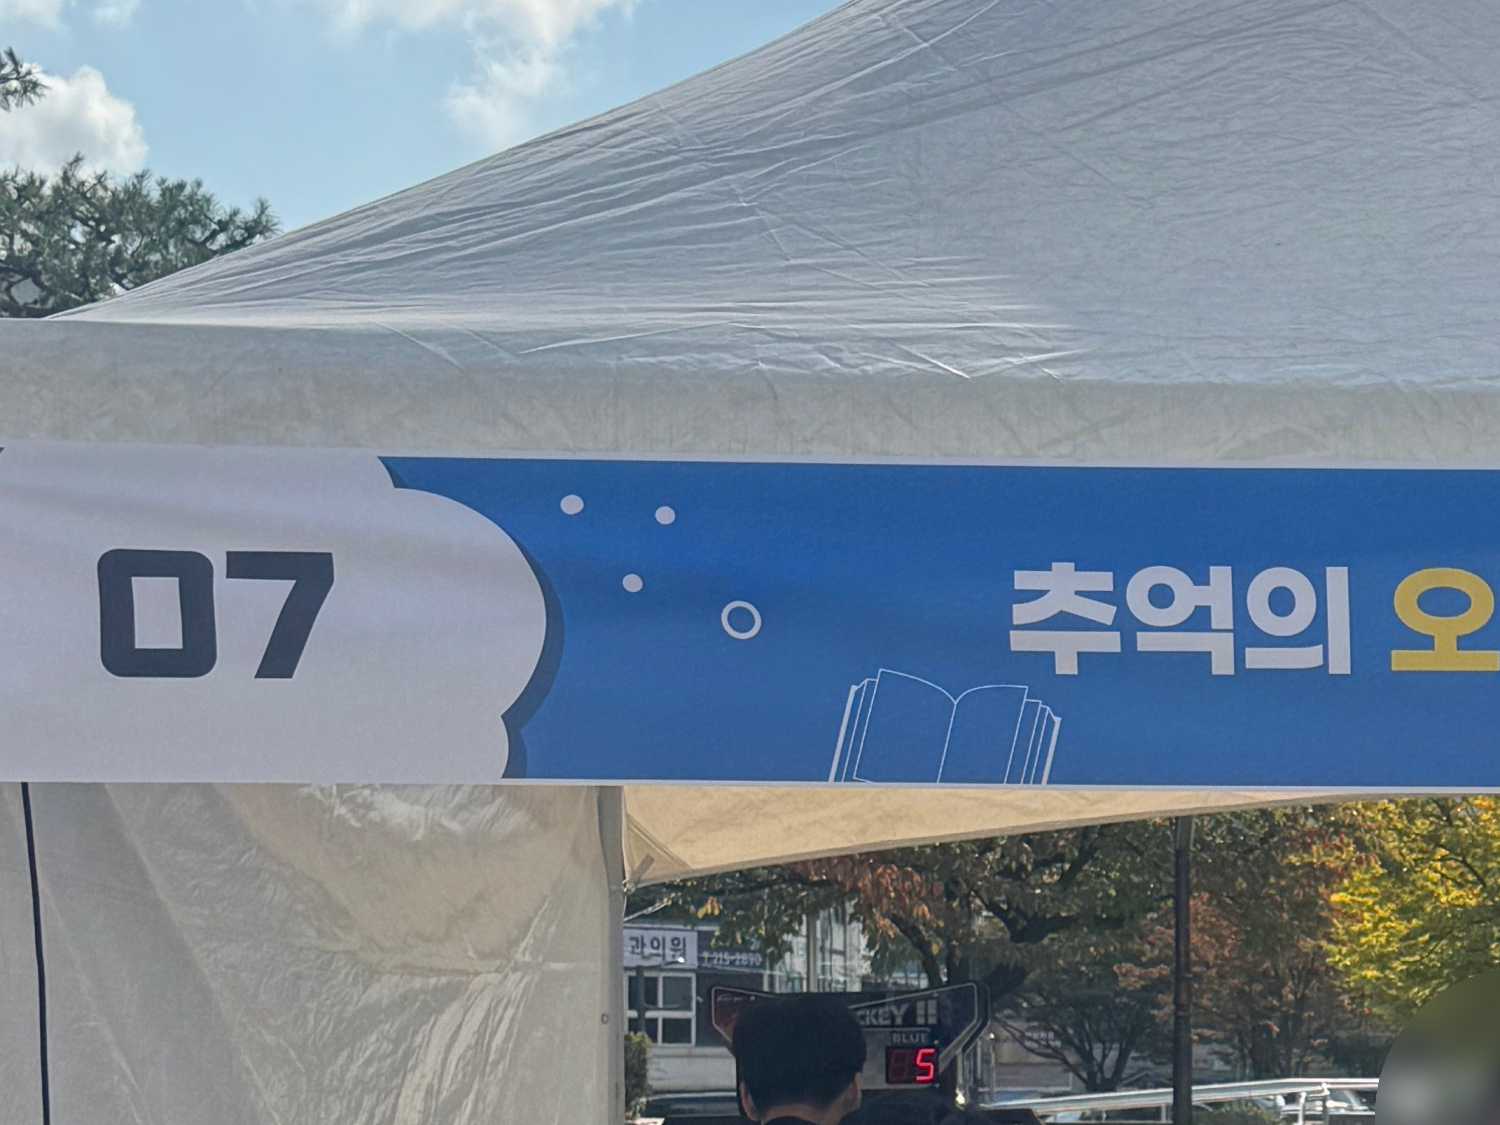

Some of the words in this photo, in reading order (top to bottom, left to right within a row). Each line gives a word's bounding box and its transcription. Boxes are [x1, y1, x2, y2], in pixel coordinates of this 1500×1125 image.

[97, 548, 335, 679] 07
[1009, 562, 1352, 676] 추억의
[914, 1047, 936, 1082] 5
